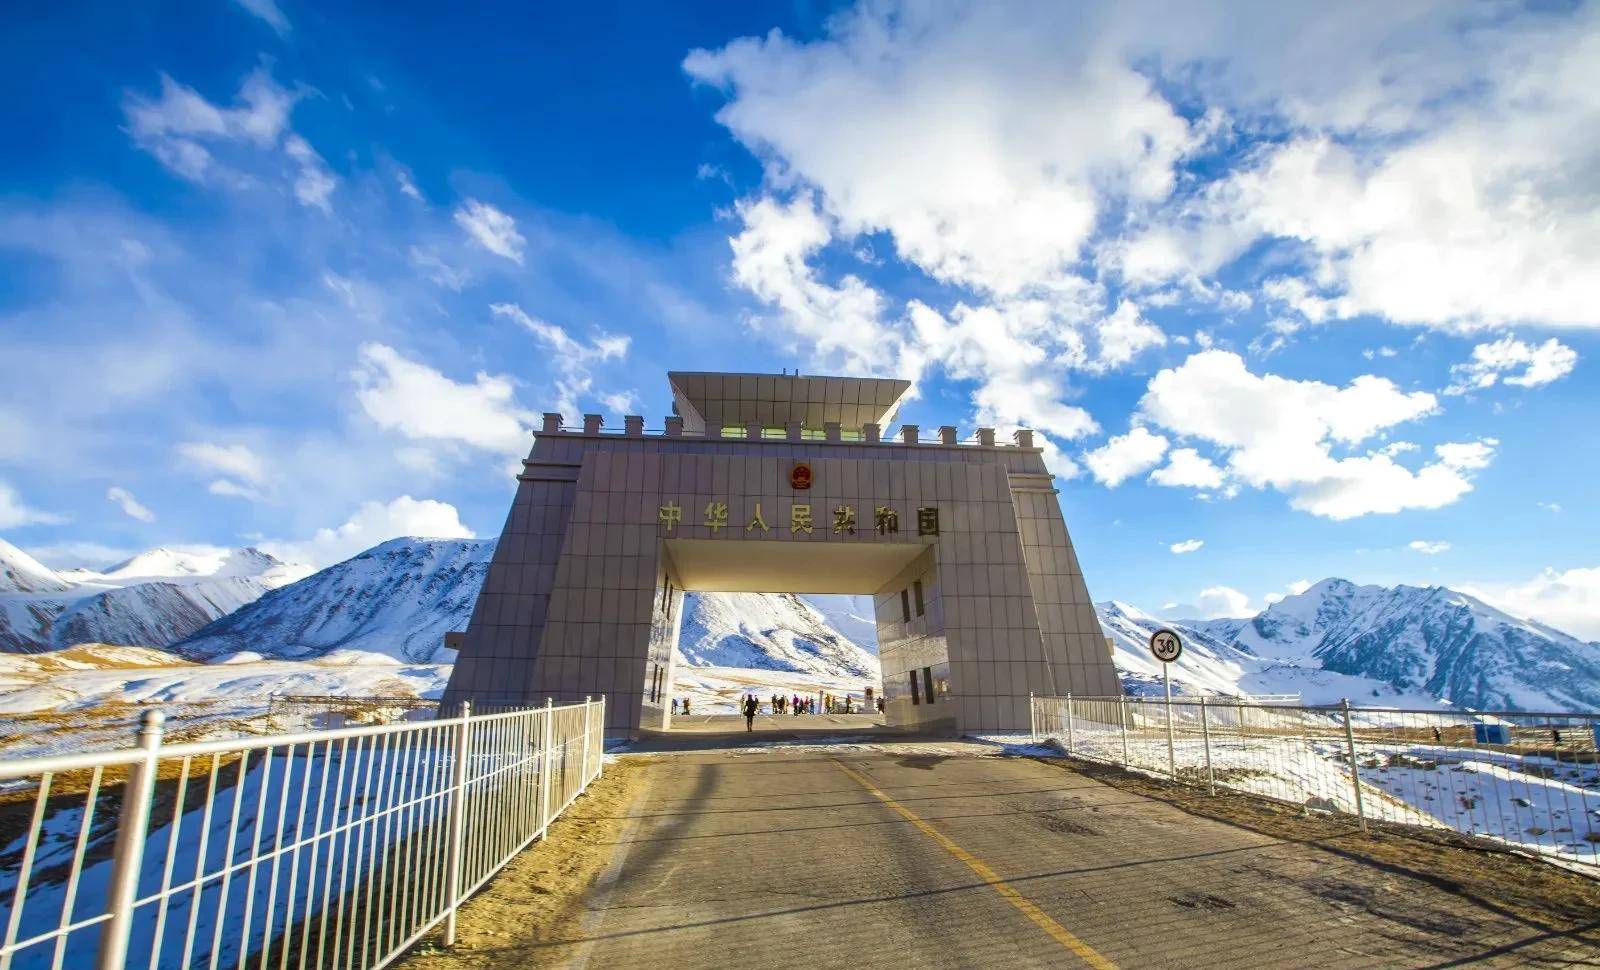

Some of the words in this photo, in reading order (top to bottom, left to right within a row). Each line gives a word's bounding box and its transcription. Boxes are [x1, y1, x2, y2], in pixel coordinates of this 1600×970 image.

[658, 500, 940, 537] 中华人民共和国
[1157, 638, 1175, 653] 30
